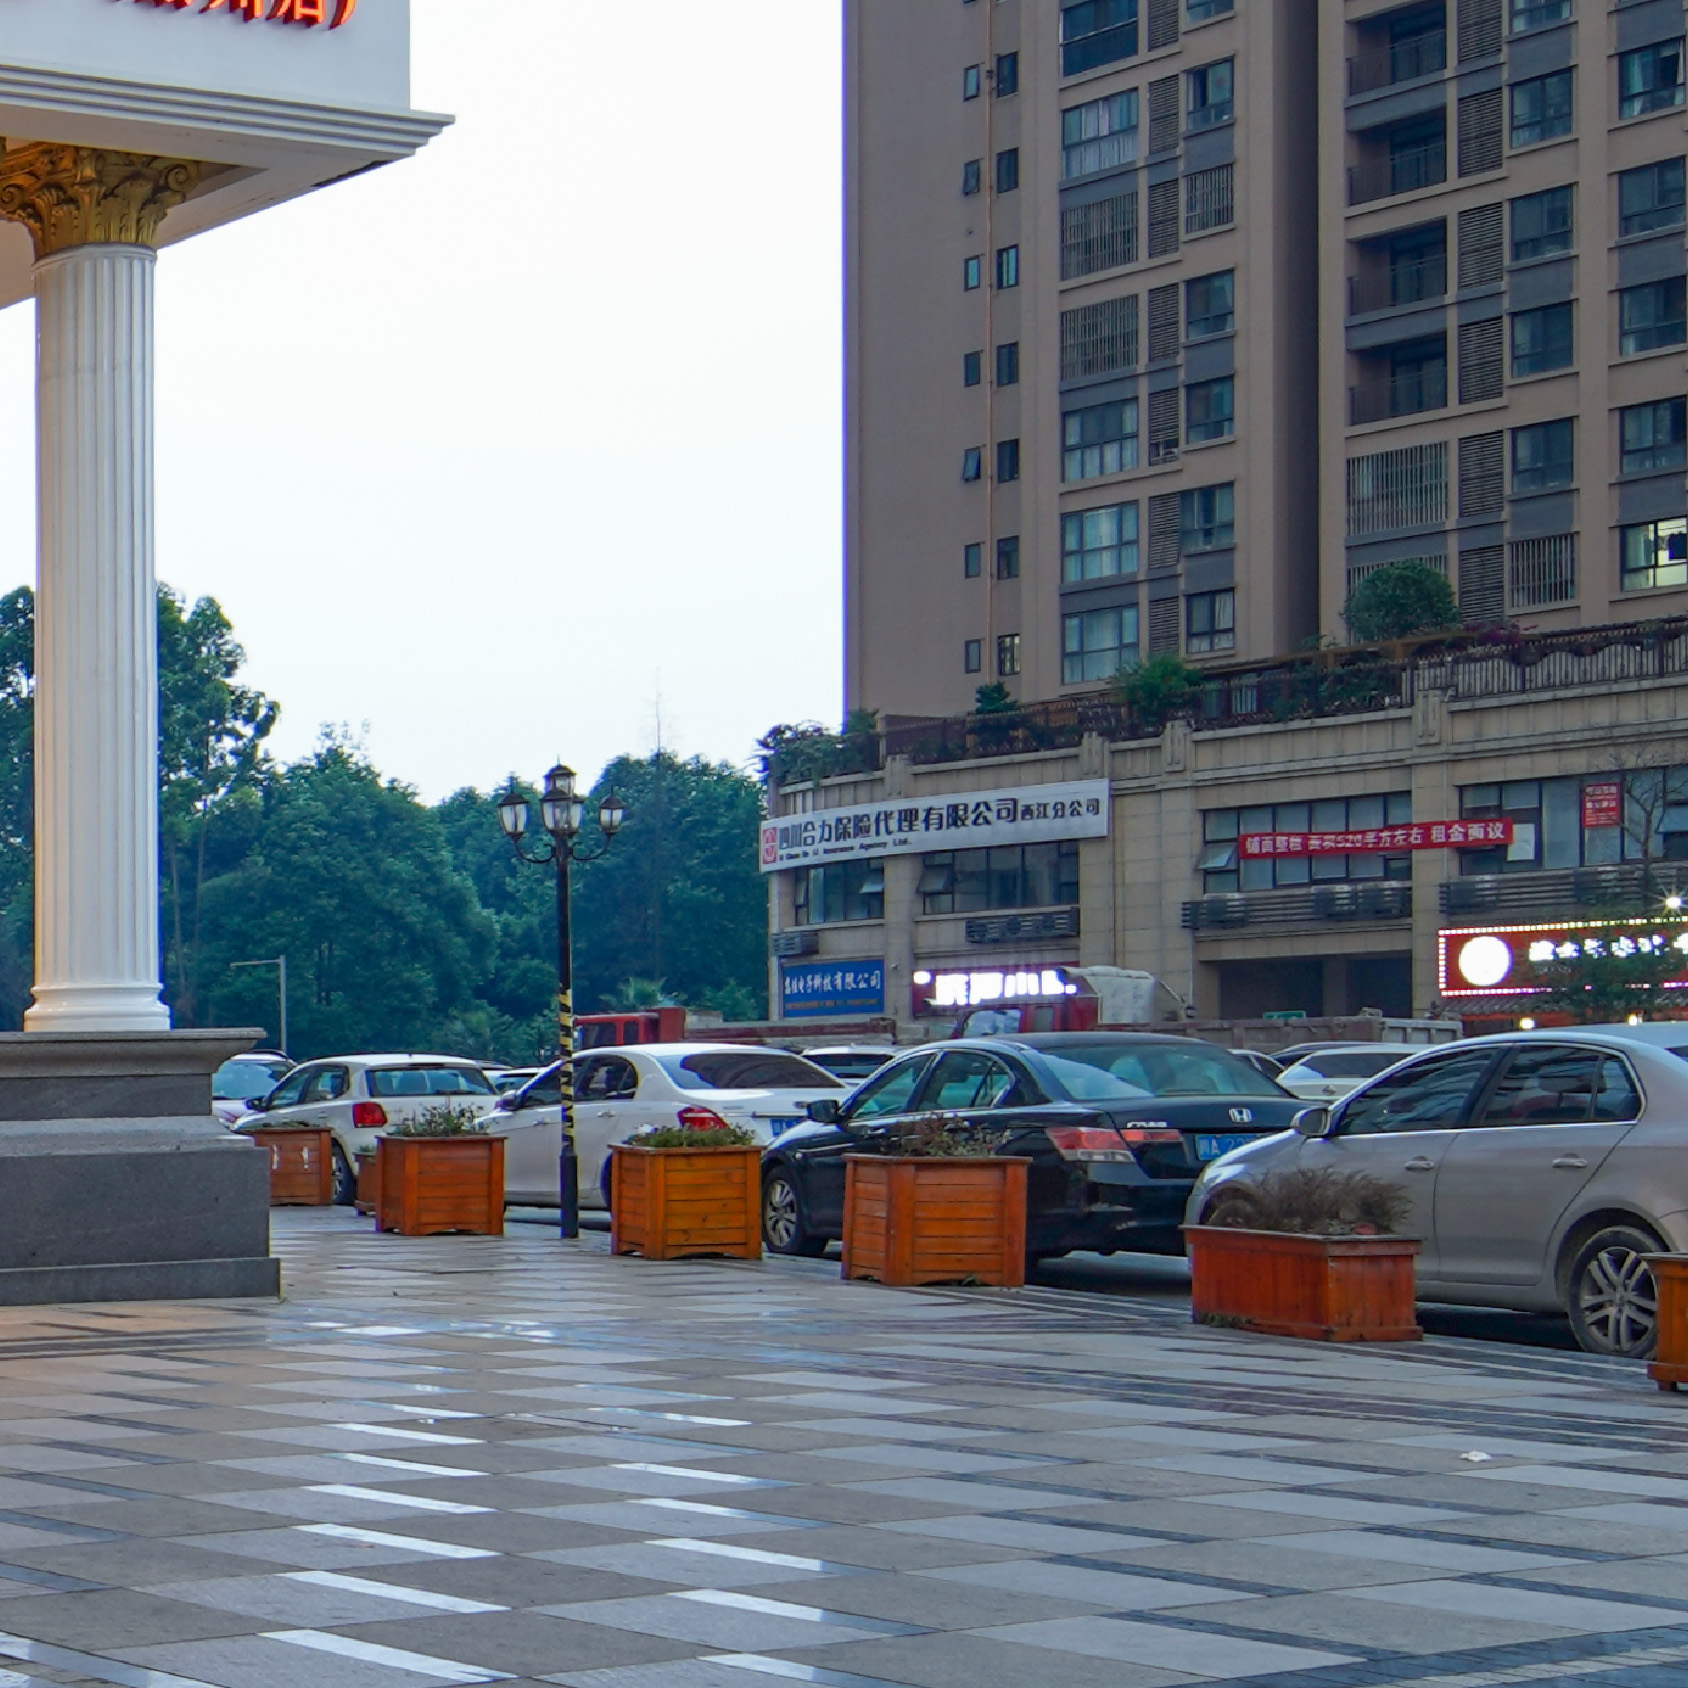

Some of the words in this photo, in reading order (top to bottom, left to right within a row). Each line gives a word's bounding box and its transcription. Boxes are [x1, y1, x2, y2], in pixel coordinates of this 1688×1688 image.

[778, 797, 1018, 851] 四川合力保险代理有限公司
